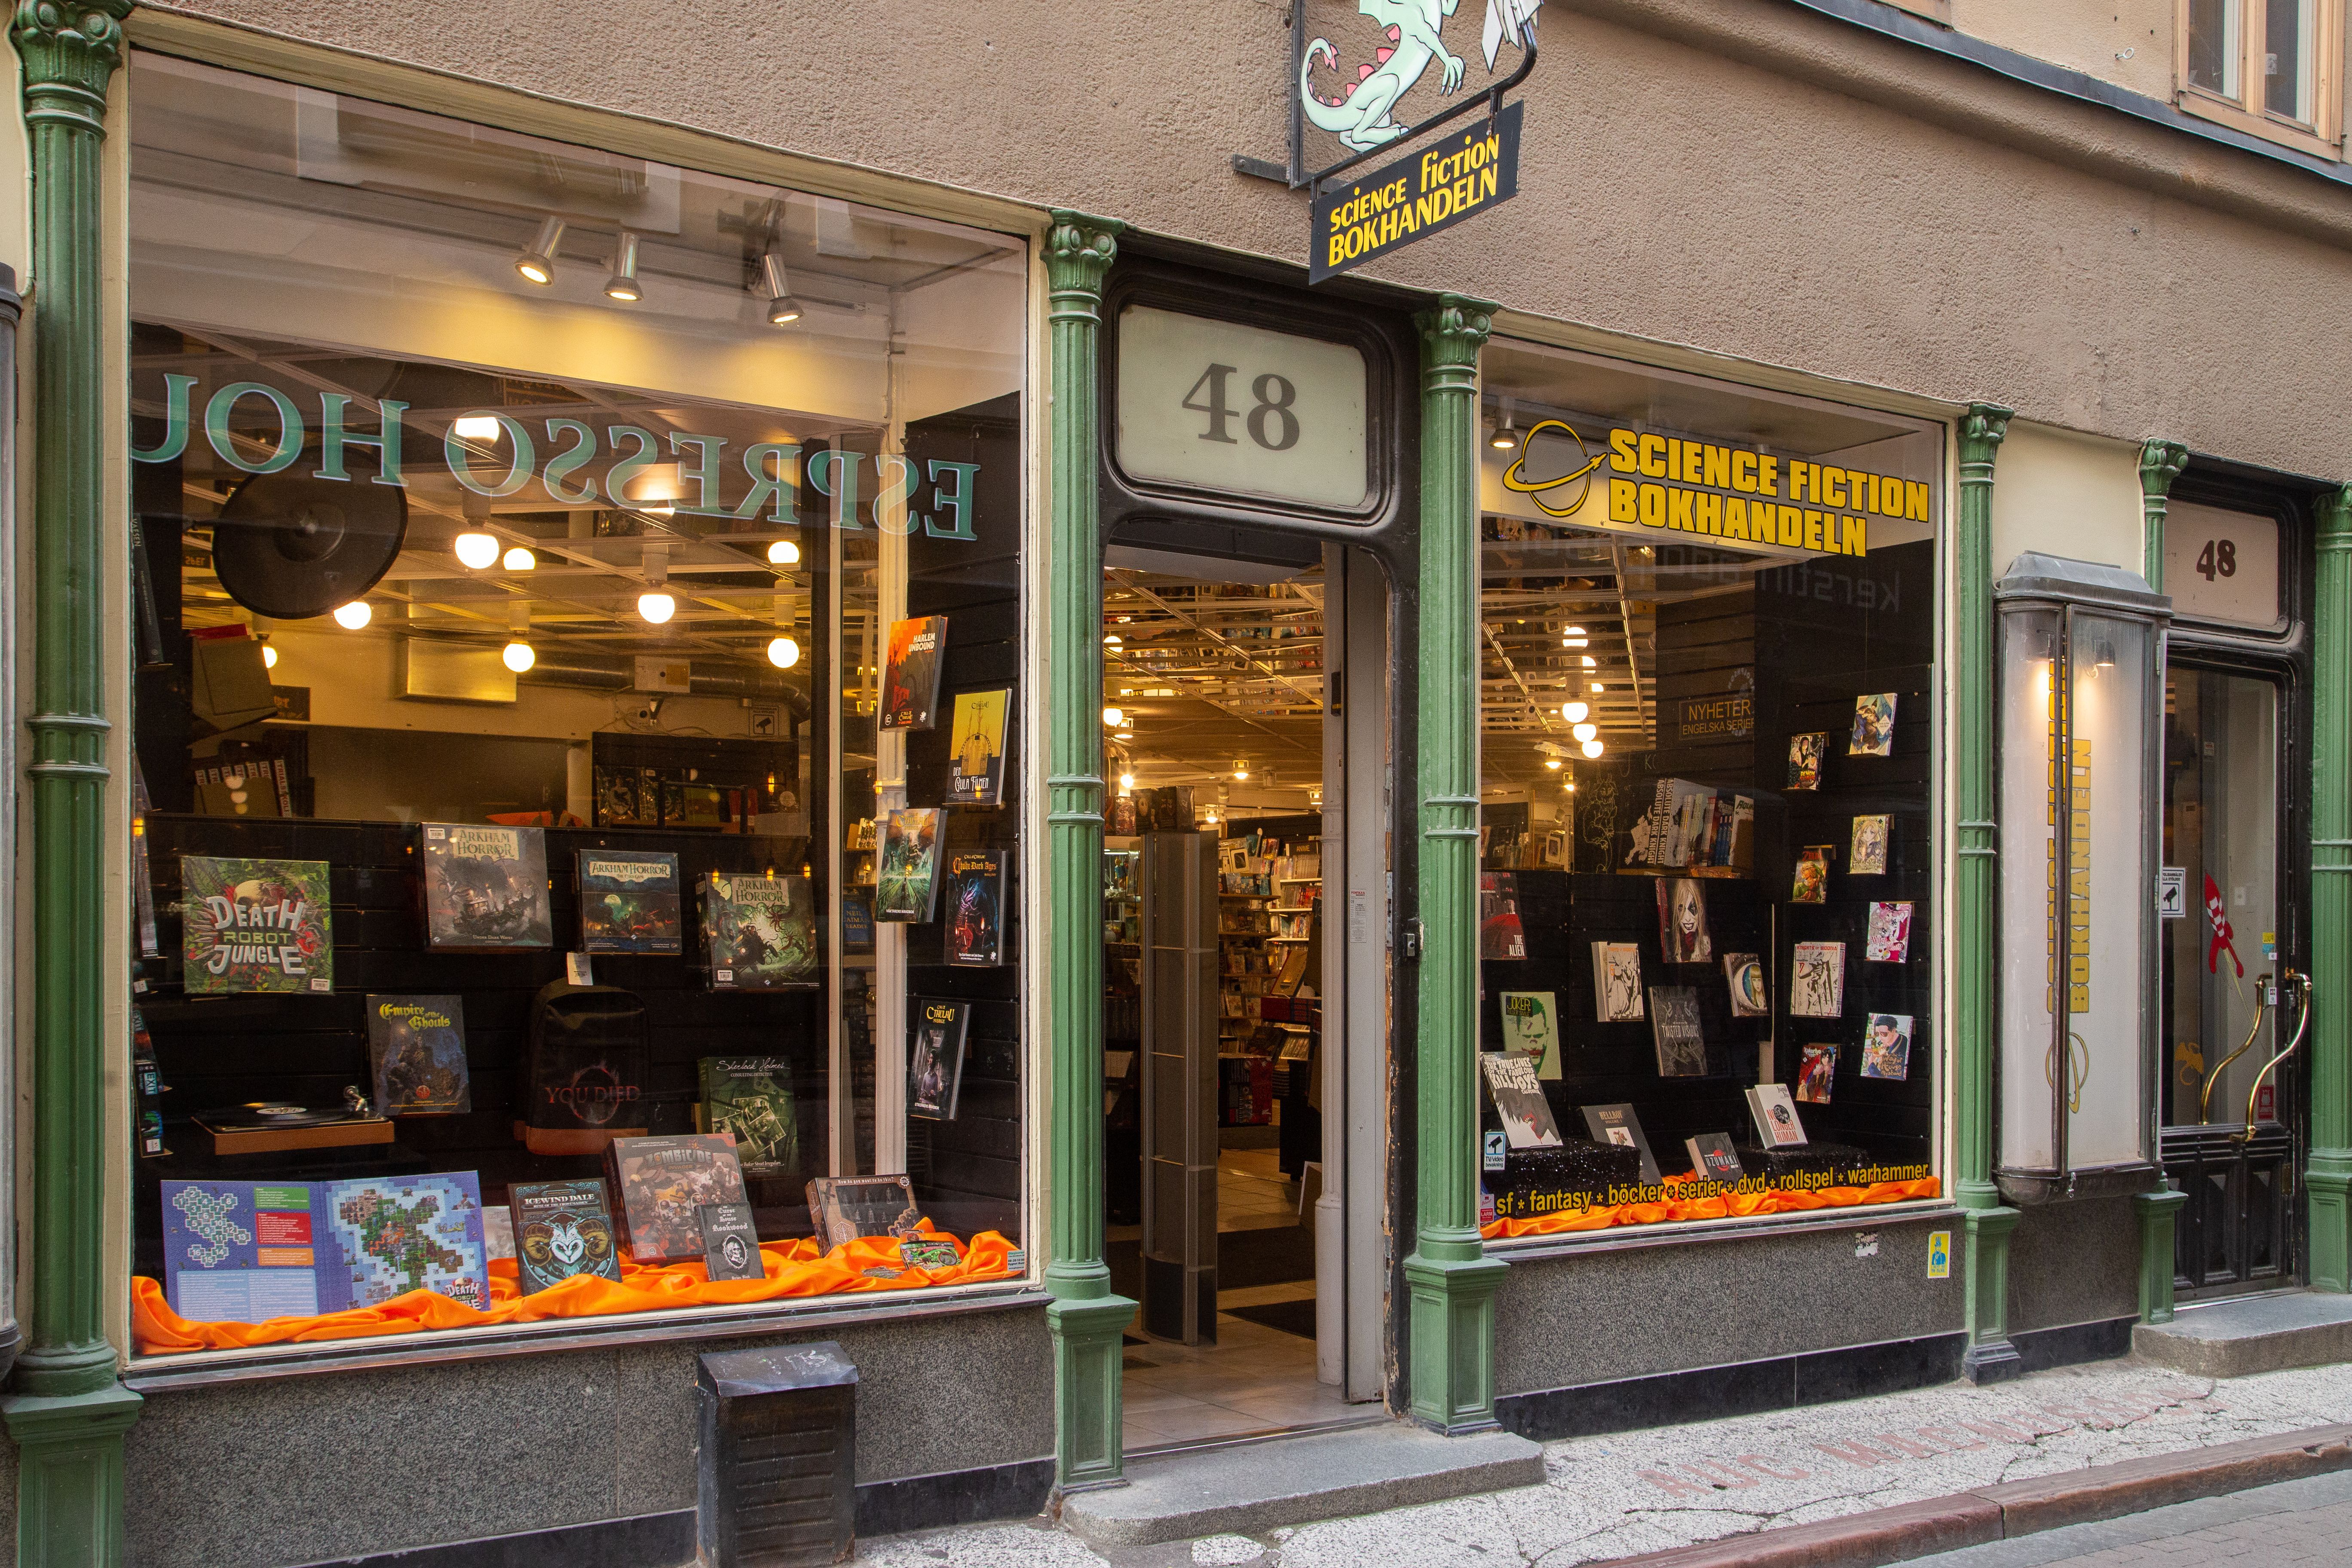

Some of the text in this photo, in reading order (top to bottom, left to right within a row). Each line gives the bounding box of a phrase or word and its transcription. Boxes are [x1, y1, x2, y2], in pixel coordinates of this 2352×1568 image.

[1328, 164, 1498, 267] BOKHANDELN
[1182, 363, 1300, 451] 48
[1608, 427, 1929, 523] SCIENCE FICTION
[1608, 477, 1866, 557] BOKHANDELN
[2196, 539, 2236, 582] 48
[913, 632, 935, 643] HARLEM
[908, 641, 934, 652] UNBOUND
[1689, 699, 1751, 721] NYHETER
[1683, 721, 1725, 735] ENGELSKA
[953, 767, 961, 776] DEN
[955, 776, 989, 792] GULA FILMEN
[1647, 779, 1665, 864] ABSOLUTE DARK KNIGHT
[1657, 779, 1674, 864] ABSOLUTE DARK KNIGHT
[459, 830, 510, 844] ARKHAM
[457, 841, 515, 858] HORROR
[592, 863, 669, 876] ARKHAM HORROR
[953, 855, 996, 875] Cthulhu Dark Ages
[2069, 738, 2091, 1014] BOKHANDELN
[738, 878, 782, 891] ARKHAM
[735, 889, 785, 903] HORROR
[206, 896, 305, 931] DEATH
[223, 931, 291, 943] ROBOT
[1514, 935, 1523, 944] THE
[1509, 944, 1525, 956] ALIEN
[207, 945, 306, 974] JUNGLE
[379, 1003, 425, 1022] Empire
[927, 1007, 954, 1021] CTHULHU
[408, 1015, 450, 1031] Ghouls
[1662, 1025, 1699, 1037] TWISTED VISIONS
[716, 1057, 790, 1072] Sherlock Holmes
[1484, 1057, 1532, 1070] THE TRUE LIVES
[1508, 1067, 1534, 1076] FABULOUS
[147, 1073, 157, 1093] EXIT
[1488, 1073, 1539, 1090] KILLJOYS
[544, 1086, 640, 1104] YOU DIED
[1599, 1110, 1623, 1120] HELLBOY
[1770, 1119, 1796, 1131] LONGER
[1774, 1130, 1798, 1142] HUMAN
[1705, 1155, 1737, 1167] UZUMAKI
[1496, 1163, 1929, 1215] sf fantasy böcker serier dvd rollspel warhammer
[524, 1196, 568, 1204] ICEWIND
[712, 1222, 748, 1232] Rookwood
[445, 1282, 479, 1297] DEATH
